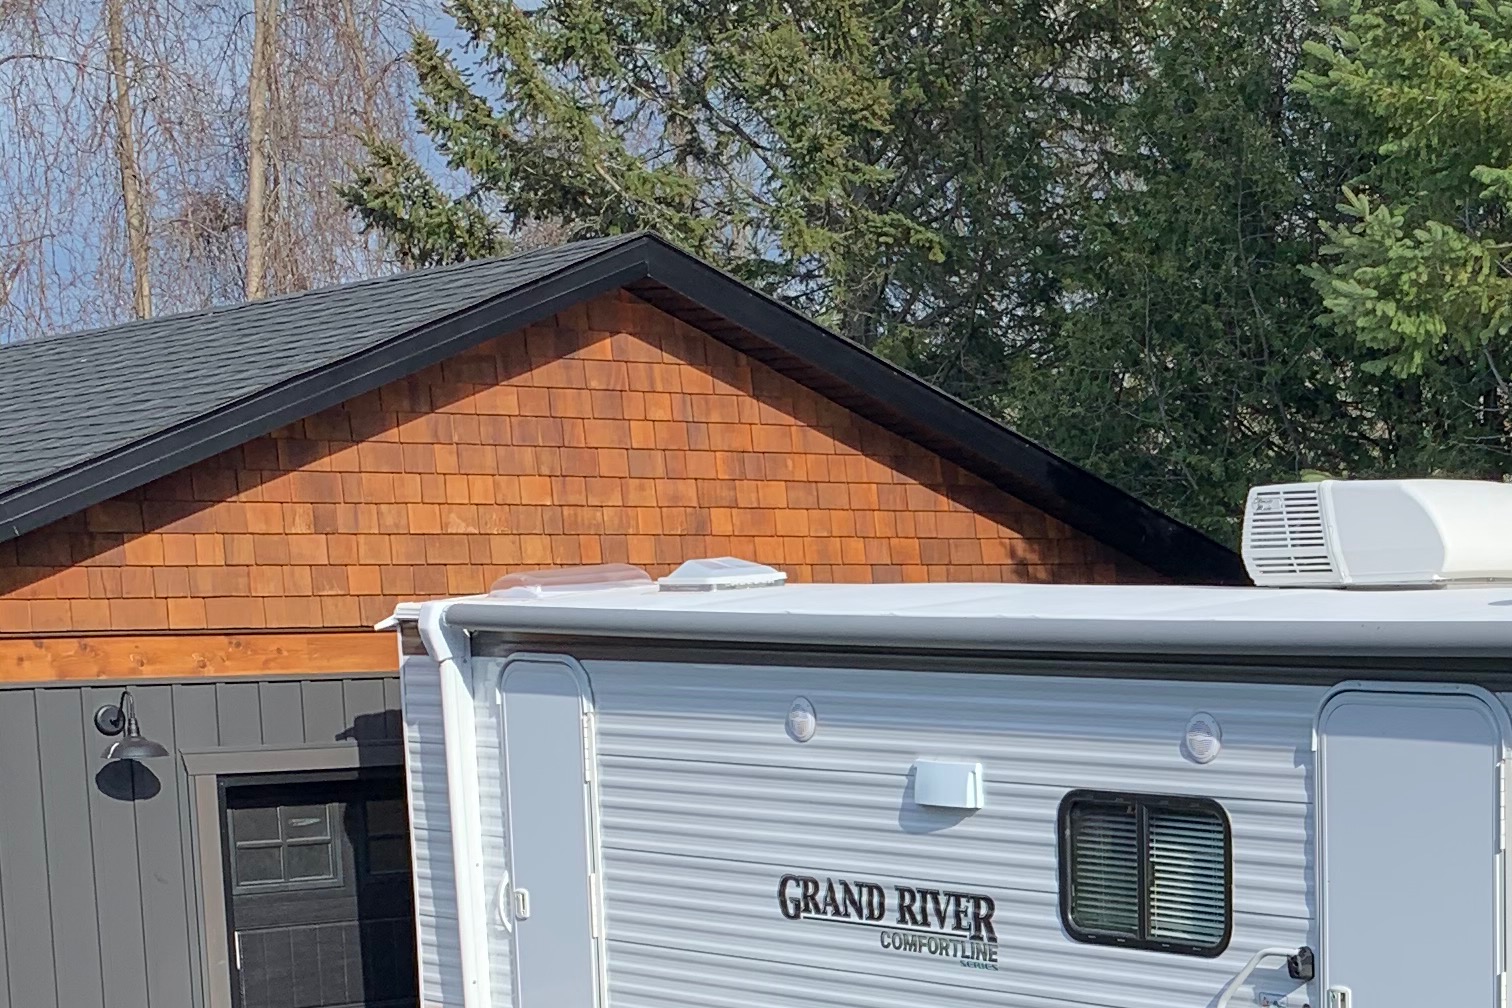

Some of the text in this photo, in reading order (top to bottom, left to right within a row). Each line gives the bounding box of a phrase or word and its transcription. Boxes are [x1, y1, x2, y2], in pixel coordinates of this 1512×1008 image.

[777, 873, 998, 944] GRAND RIVER
[880, 930, 998, 963] COMFORTLINE
